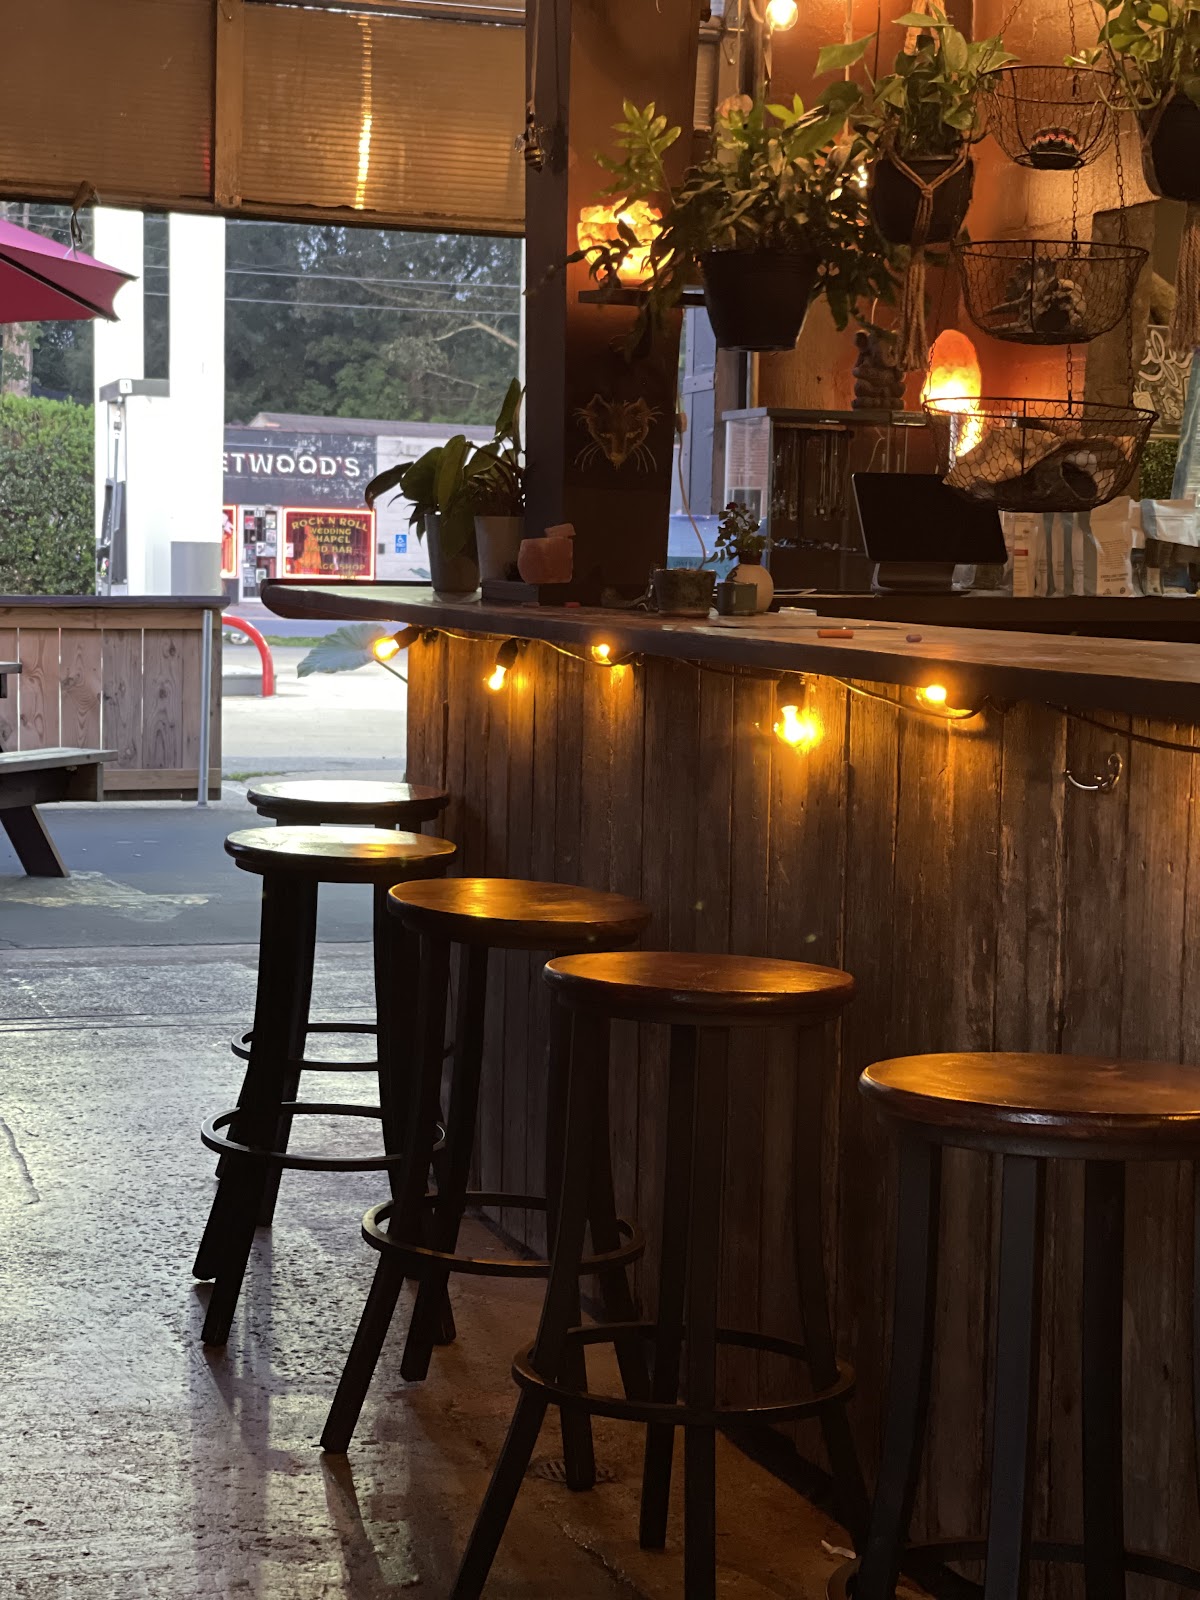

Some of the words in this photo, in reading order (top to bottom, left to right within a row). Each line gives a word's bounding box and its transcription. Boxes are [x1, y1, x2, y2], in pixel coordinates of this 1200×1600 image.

[292, 517, 324, 530] ROCK
[328, 516, 336, 525] N
[339, 517, 368, 532] ROLL
[332, 546, 353, 554] BAR
[340, 563, 366, 571] SHOP
